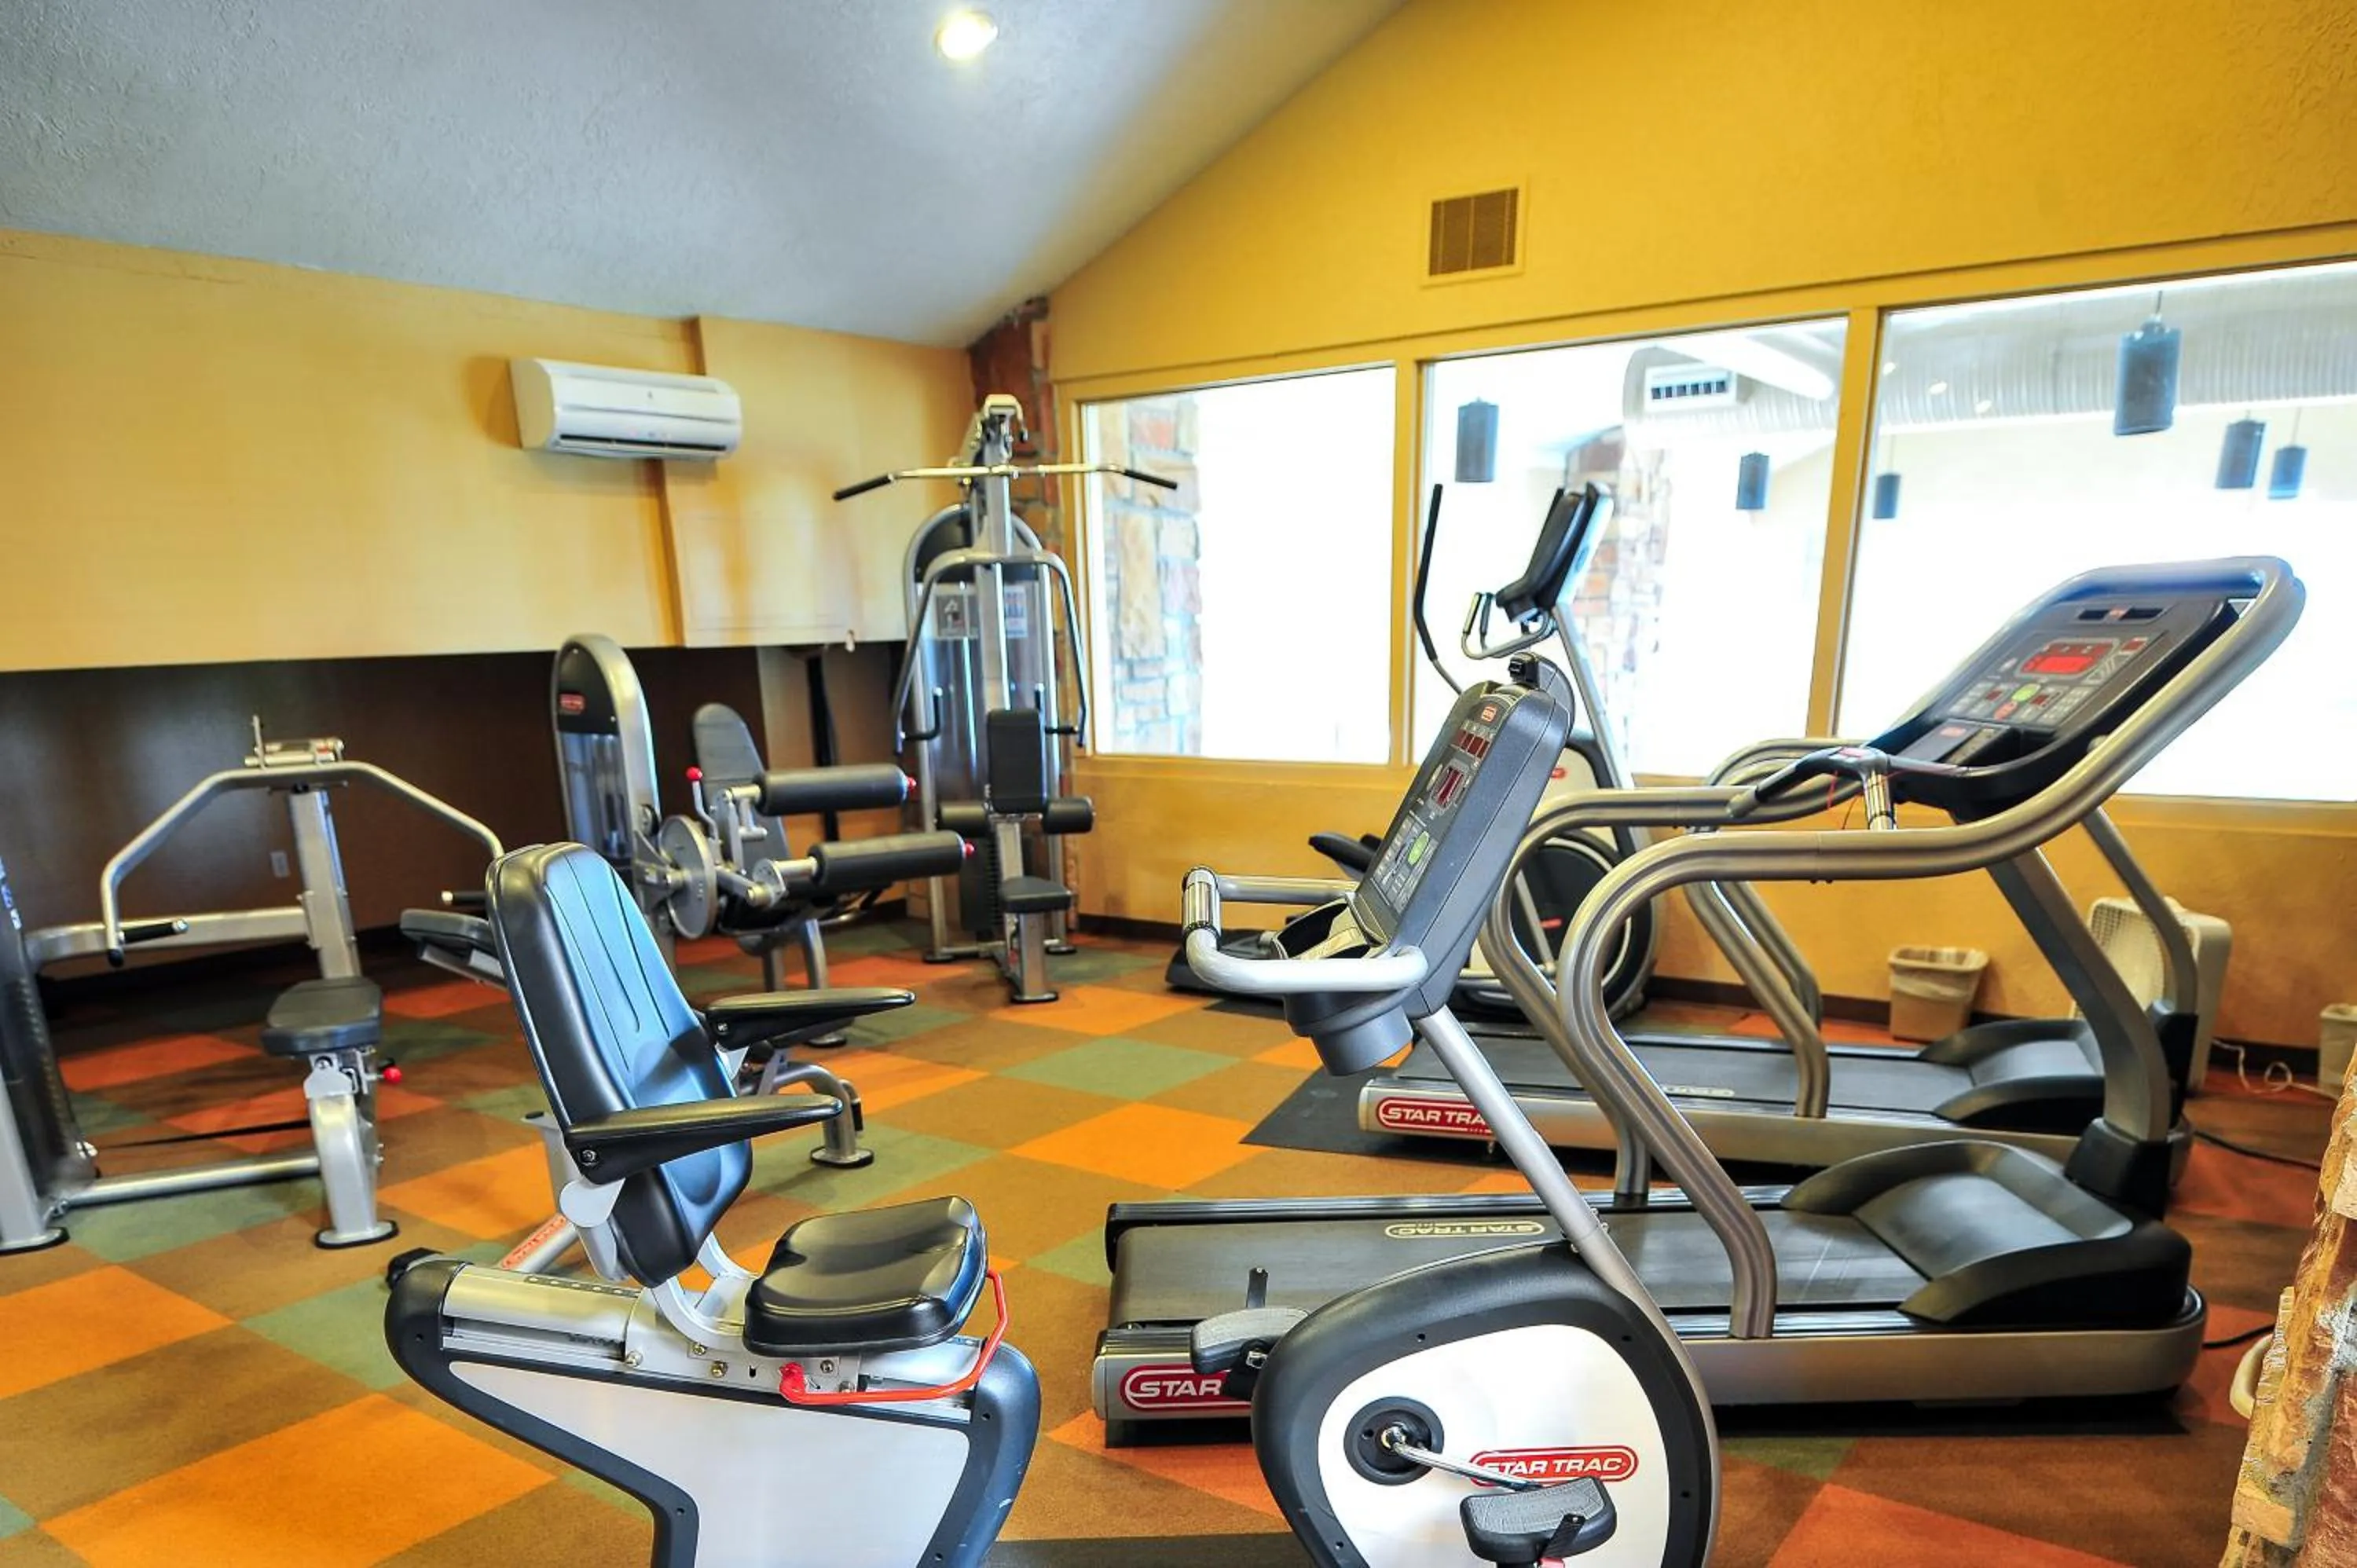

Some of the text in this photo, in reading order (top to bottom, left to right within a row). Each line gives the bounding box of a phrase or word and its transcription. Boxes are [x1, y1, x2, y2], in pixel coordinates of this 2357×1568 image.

[1384, 1107, 1486, 1125] STAR TRA
[1398, 1225, 1533, 1235] STAR TRAC
[1131, 1379, 1222, 1398] STAR
[1552, 1457, 1622, 1472] TRAC
